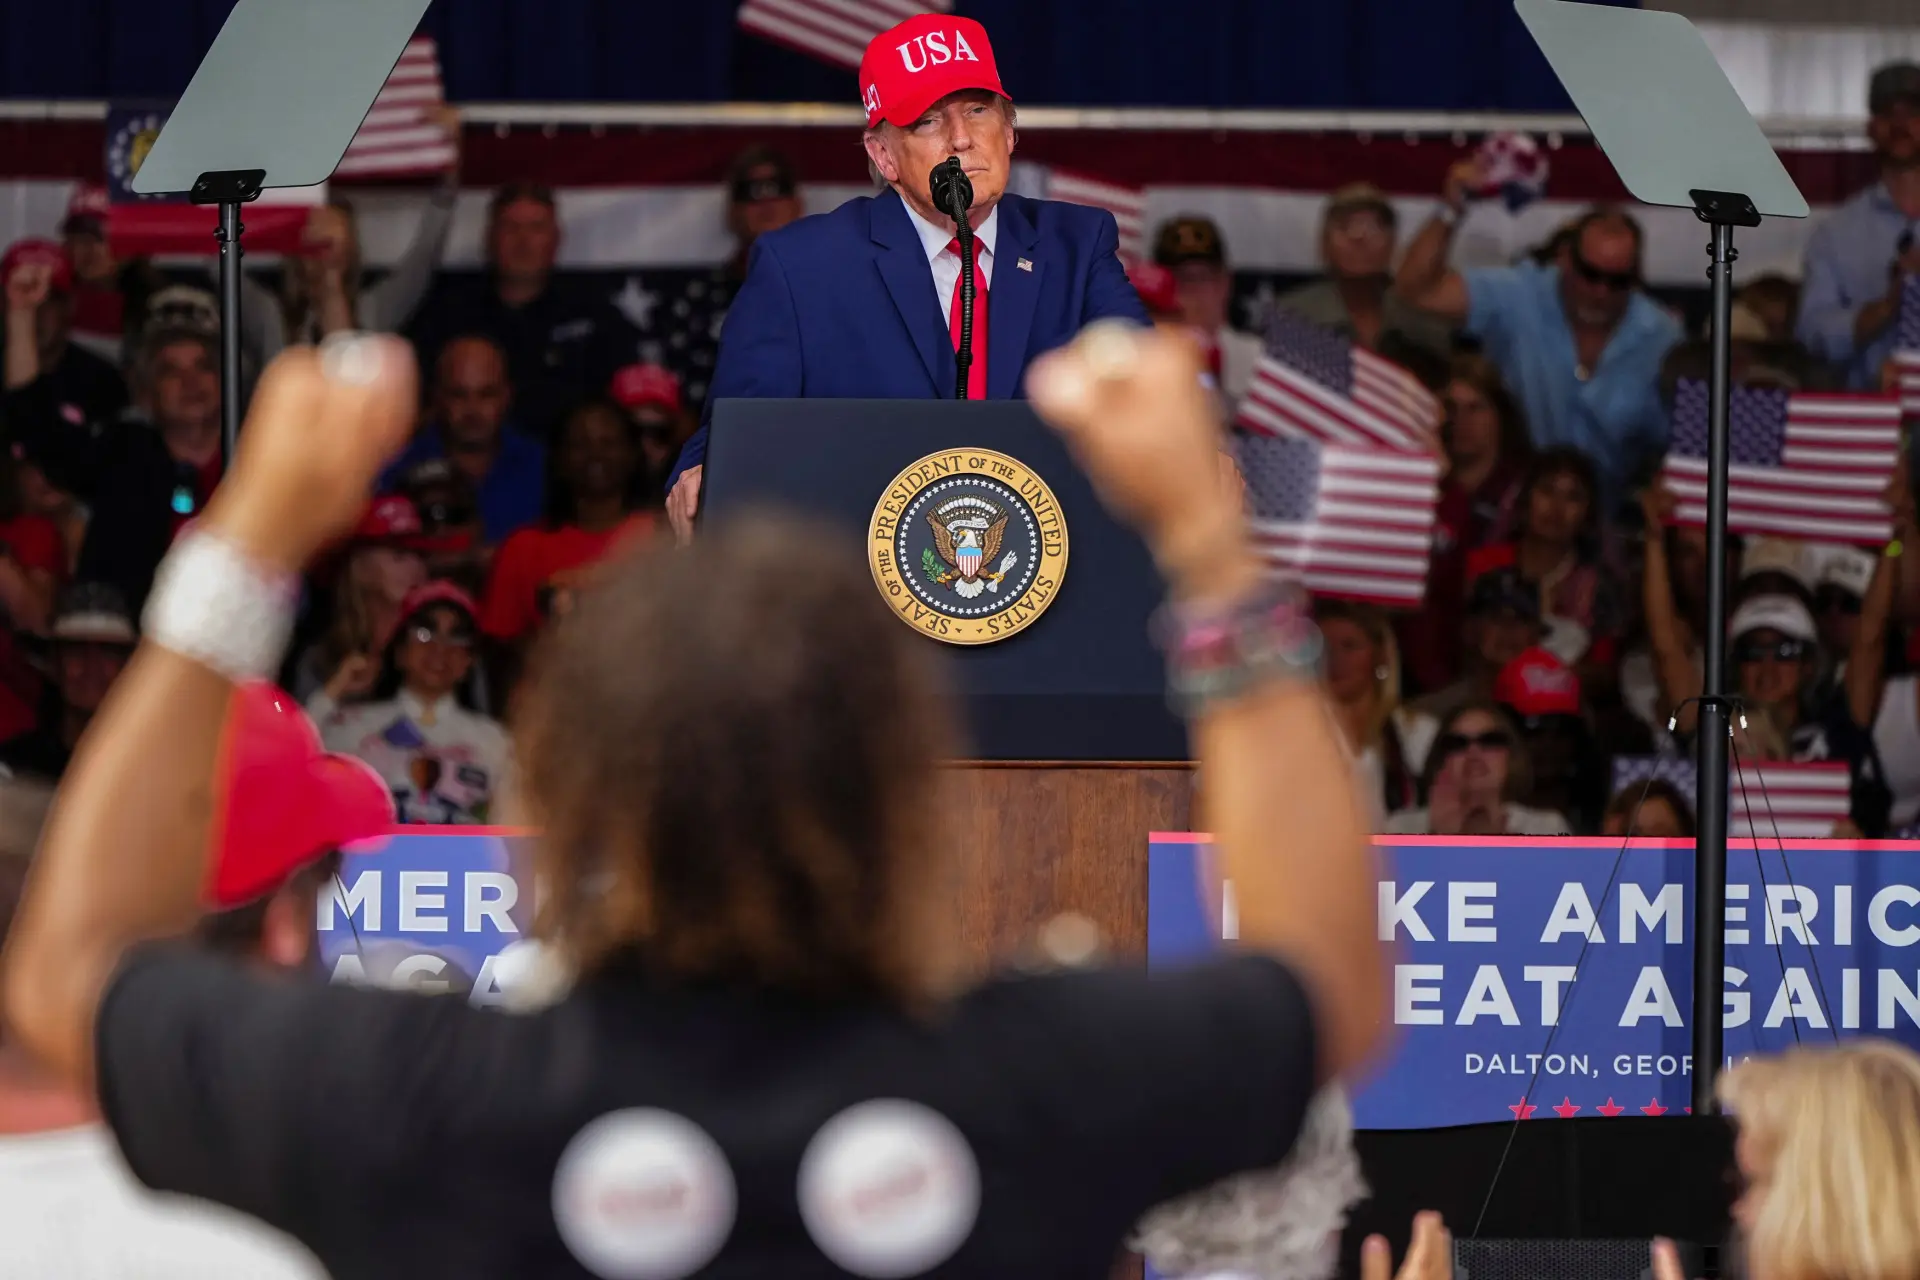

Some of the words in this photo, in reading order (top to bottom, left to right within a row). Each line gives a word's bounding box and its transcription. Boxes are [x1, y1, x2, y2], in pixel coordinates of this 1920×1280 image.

[896, 29, 979, 73] USA
[968, 456, 987, 469] OF
[991, 460, 1017, 481] THE
[875, 455, 962, 542] PRESIDENT
[1020, 476, 1062, 558] UNITED
[877, 548, 894, 577] THE
[885, 579, 902, 596] OF
[900, 591, 952, 635] SEAL
[986, 574, 1054, 635] STATES
[316, 870, 530, 933] MER
[1222, 880, 1498, 942] KE
[329, 953, 515, 1010] AGA
[1394, 964, 1577, 1027] EAT
[1465, 1053, 1599, 1078] DALTON,
[1613, 1054, 1752, 1076] GEORI
